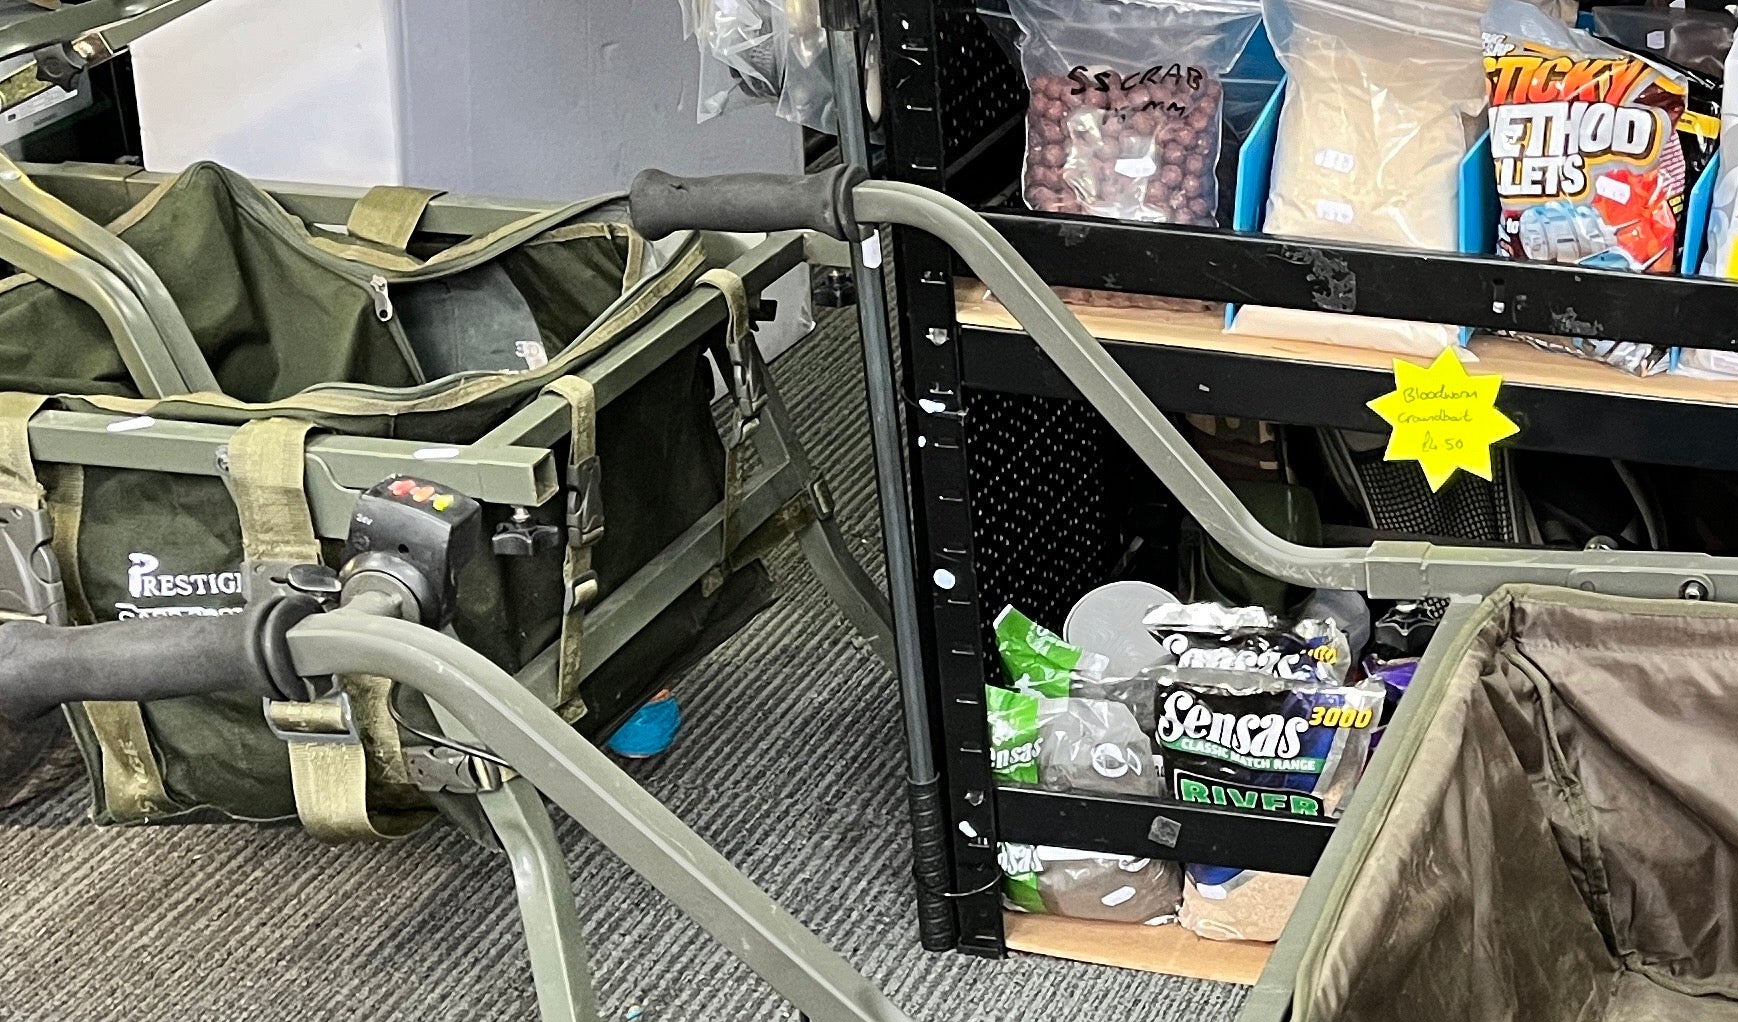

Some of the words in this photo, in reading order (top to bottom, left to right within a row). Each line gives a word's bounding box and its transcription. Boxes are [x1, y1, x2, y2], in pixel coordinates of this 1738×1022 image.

[1120, 63, 1203, 91] CRAB
[1157, 690, 1309, 758] Sensas
[1309, 706, 1374, 729] 3000
[1181, 739, 1229, 759] CLASSIC
[1230, 750, 1270, 769] MATCH
[1273, 758, 1316, 771] RANGE
